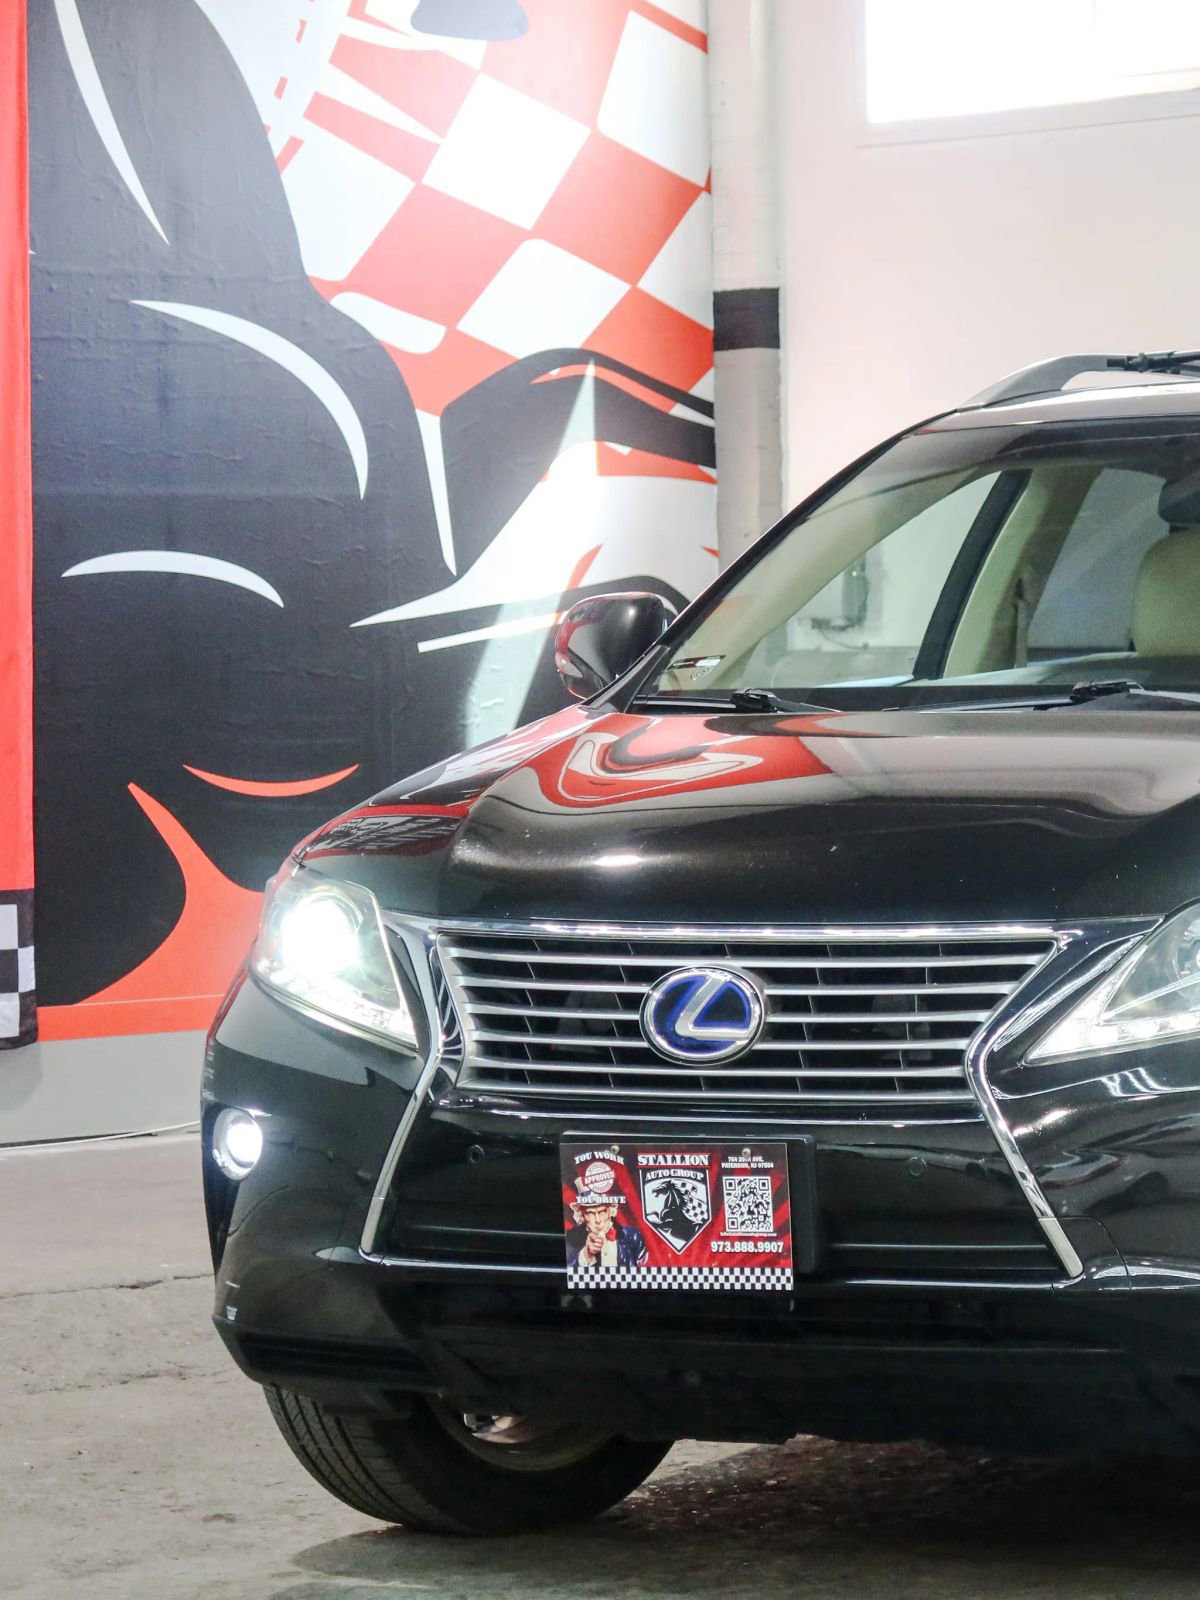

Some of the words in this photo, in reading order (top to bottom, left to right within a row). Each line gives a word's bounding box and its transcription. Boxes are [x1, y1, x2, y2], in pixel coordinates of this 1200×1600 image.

[574, 1152, 593, 1165] YOU
[594, 1150, 625, 1166] WORK
[637, 1154, 709, 1166] STALLION
[584, 1170, 615, 1185] APPROVED
[645, 1169, 670, 1181] AUTO
[670, 1168, 704, 1181] GROUP
[576, 1196, 594, 1204] YOU
[596, 1196, 626, 1204] DRIVE
[710, 1241, 784, 1253] 973.888.9907
